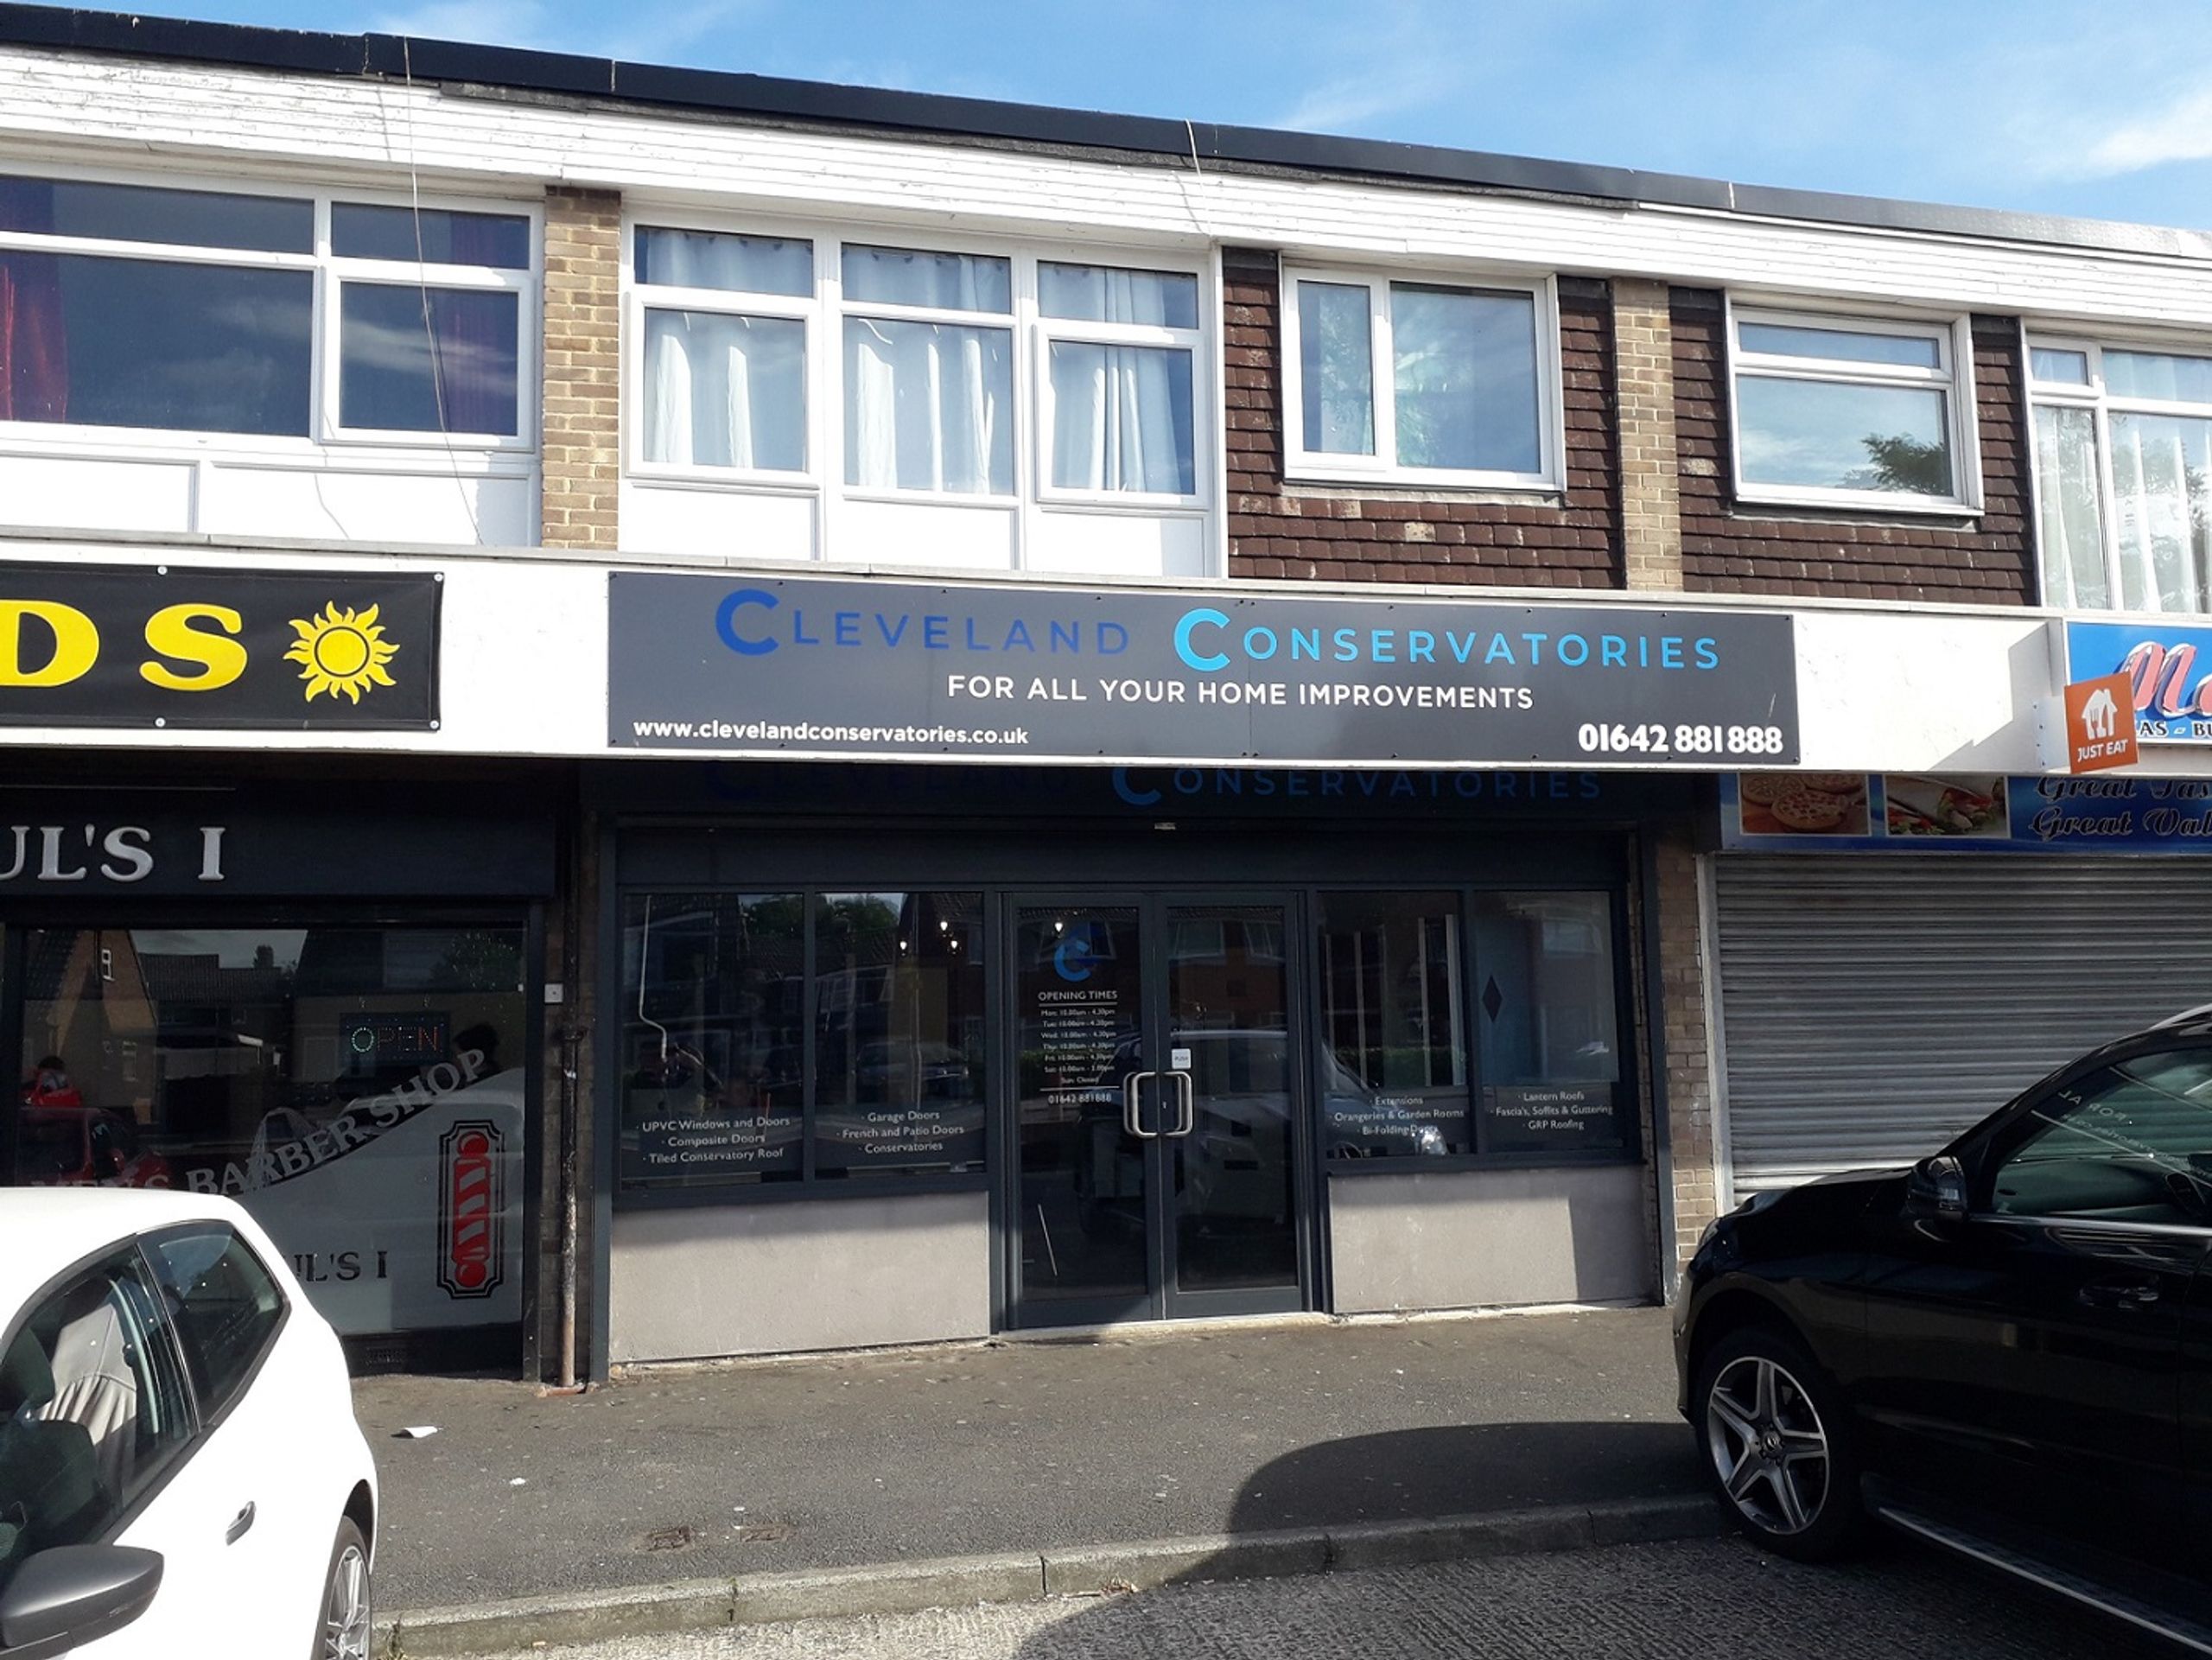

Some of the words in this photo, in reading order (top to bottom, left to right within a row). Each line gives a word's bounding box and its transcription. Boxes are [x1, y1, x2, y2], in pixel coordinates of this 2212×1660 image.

[715, 588, 1128, 655] CLEVELAND
[1174, 607, 1721, 671] CONSERVATORIES
[947, 674, 1014, 698] FOR
[1027, 677, 1087, 702] ALL
[1100, 679, 1185, 703] YOUR
[1198, 682, 1286, 706] HOME
[1300, 684, 1533, 709] IMPROVEMENTS
[633, 718, 1029, 746] www.clevelandconservatories.co.uk
[2137, 721, 2169, 737] AS
[1579, 723, 1669, 753] 01642
[2077, 743, 2104, 762] JUST
[2106, 740, 2128, 755] EAT
[1112, 767, 1601, 805] CONSERVATORIES
[2036, 778, 2136, 804] Great
[2029, 806, 2133, 842] Great
[1038, 990, 1087, 1002] OPENING
[1088, 989, 1118, 1000] TIMES
[352, 1026, 439, 1053] OPEN
[368, 1048, 486, 1128] SHOP
[1523, 1091, 1559, 1102] Lantern
[1560, 1091, 1585, 1101] Roofs
[1375, 1095, 1424, 1106] Extensions
[642, 1122, 677, 1133] UPVC
[678, 1119, 731, 1131] Windows
[733, 1118, 753, 1129] and
[756, 1116, 791, 1127] Doors
[868, 1111, 906, 1123] Garage
[907, 1110, 940, 1121] Doors
[1334, 1111, 1386, 1123] Orangeries
[1397, 1110, 1432, 1119] Garden
[1433, 1109, 1465, 1118] Rooms
[1550, 1118, 1585, 1130] Roofing
[842, 1128, 879, 1139] French
[881, 1126, 899, 1136] and
[903, 1125, 930, 1136] Patio
[932, 1123, 965, 1135] Doors
[668, 1135, 728, 1148] Composite
[732, 1134, 766, 1144] Doors
[865, 1141, 944, 1154] Conservatories
[649, 1152, 677, 1164] Tiled
[679, 1149, 755, 1162] Conservatory
[757, 1147, 785, 1158] Roof
